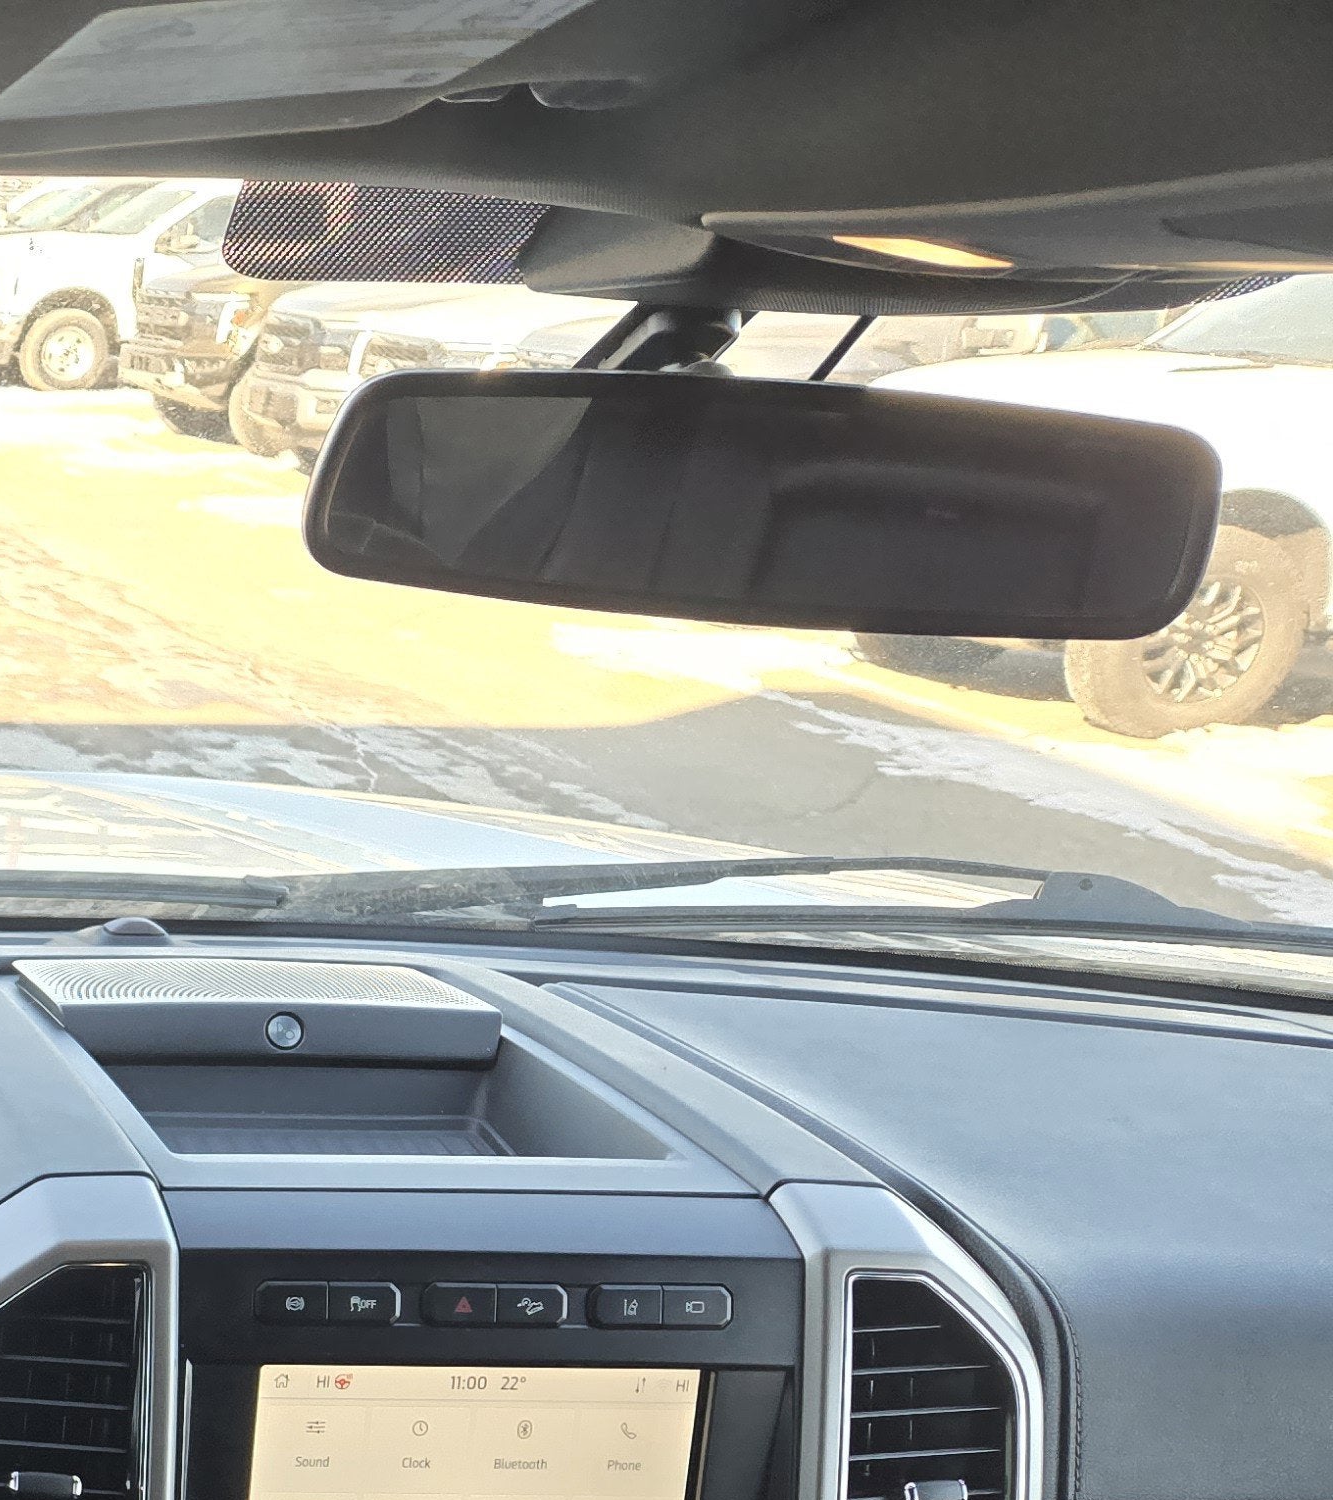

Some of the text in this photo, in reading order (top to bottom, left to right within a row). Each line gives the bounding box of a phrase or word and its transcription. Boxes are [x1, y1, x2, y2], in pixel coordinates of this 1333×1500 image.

[361, 1299, 377, 1310] OFF
[316, 1375, 330, 1389] HI
[450, 1375, 527, 1391] 11:00 22°
[294, 1455, 330, 1468] Sound
[401, 1456, 431, 1469] Clock
[493, 1458, 548, 1470] Bluetooth
[607, 1459, 642, 1472] Phone
